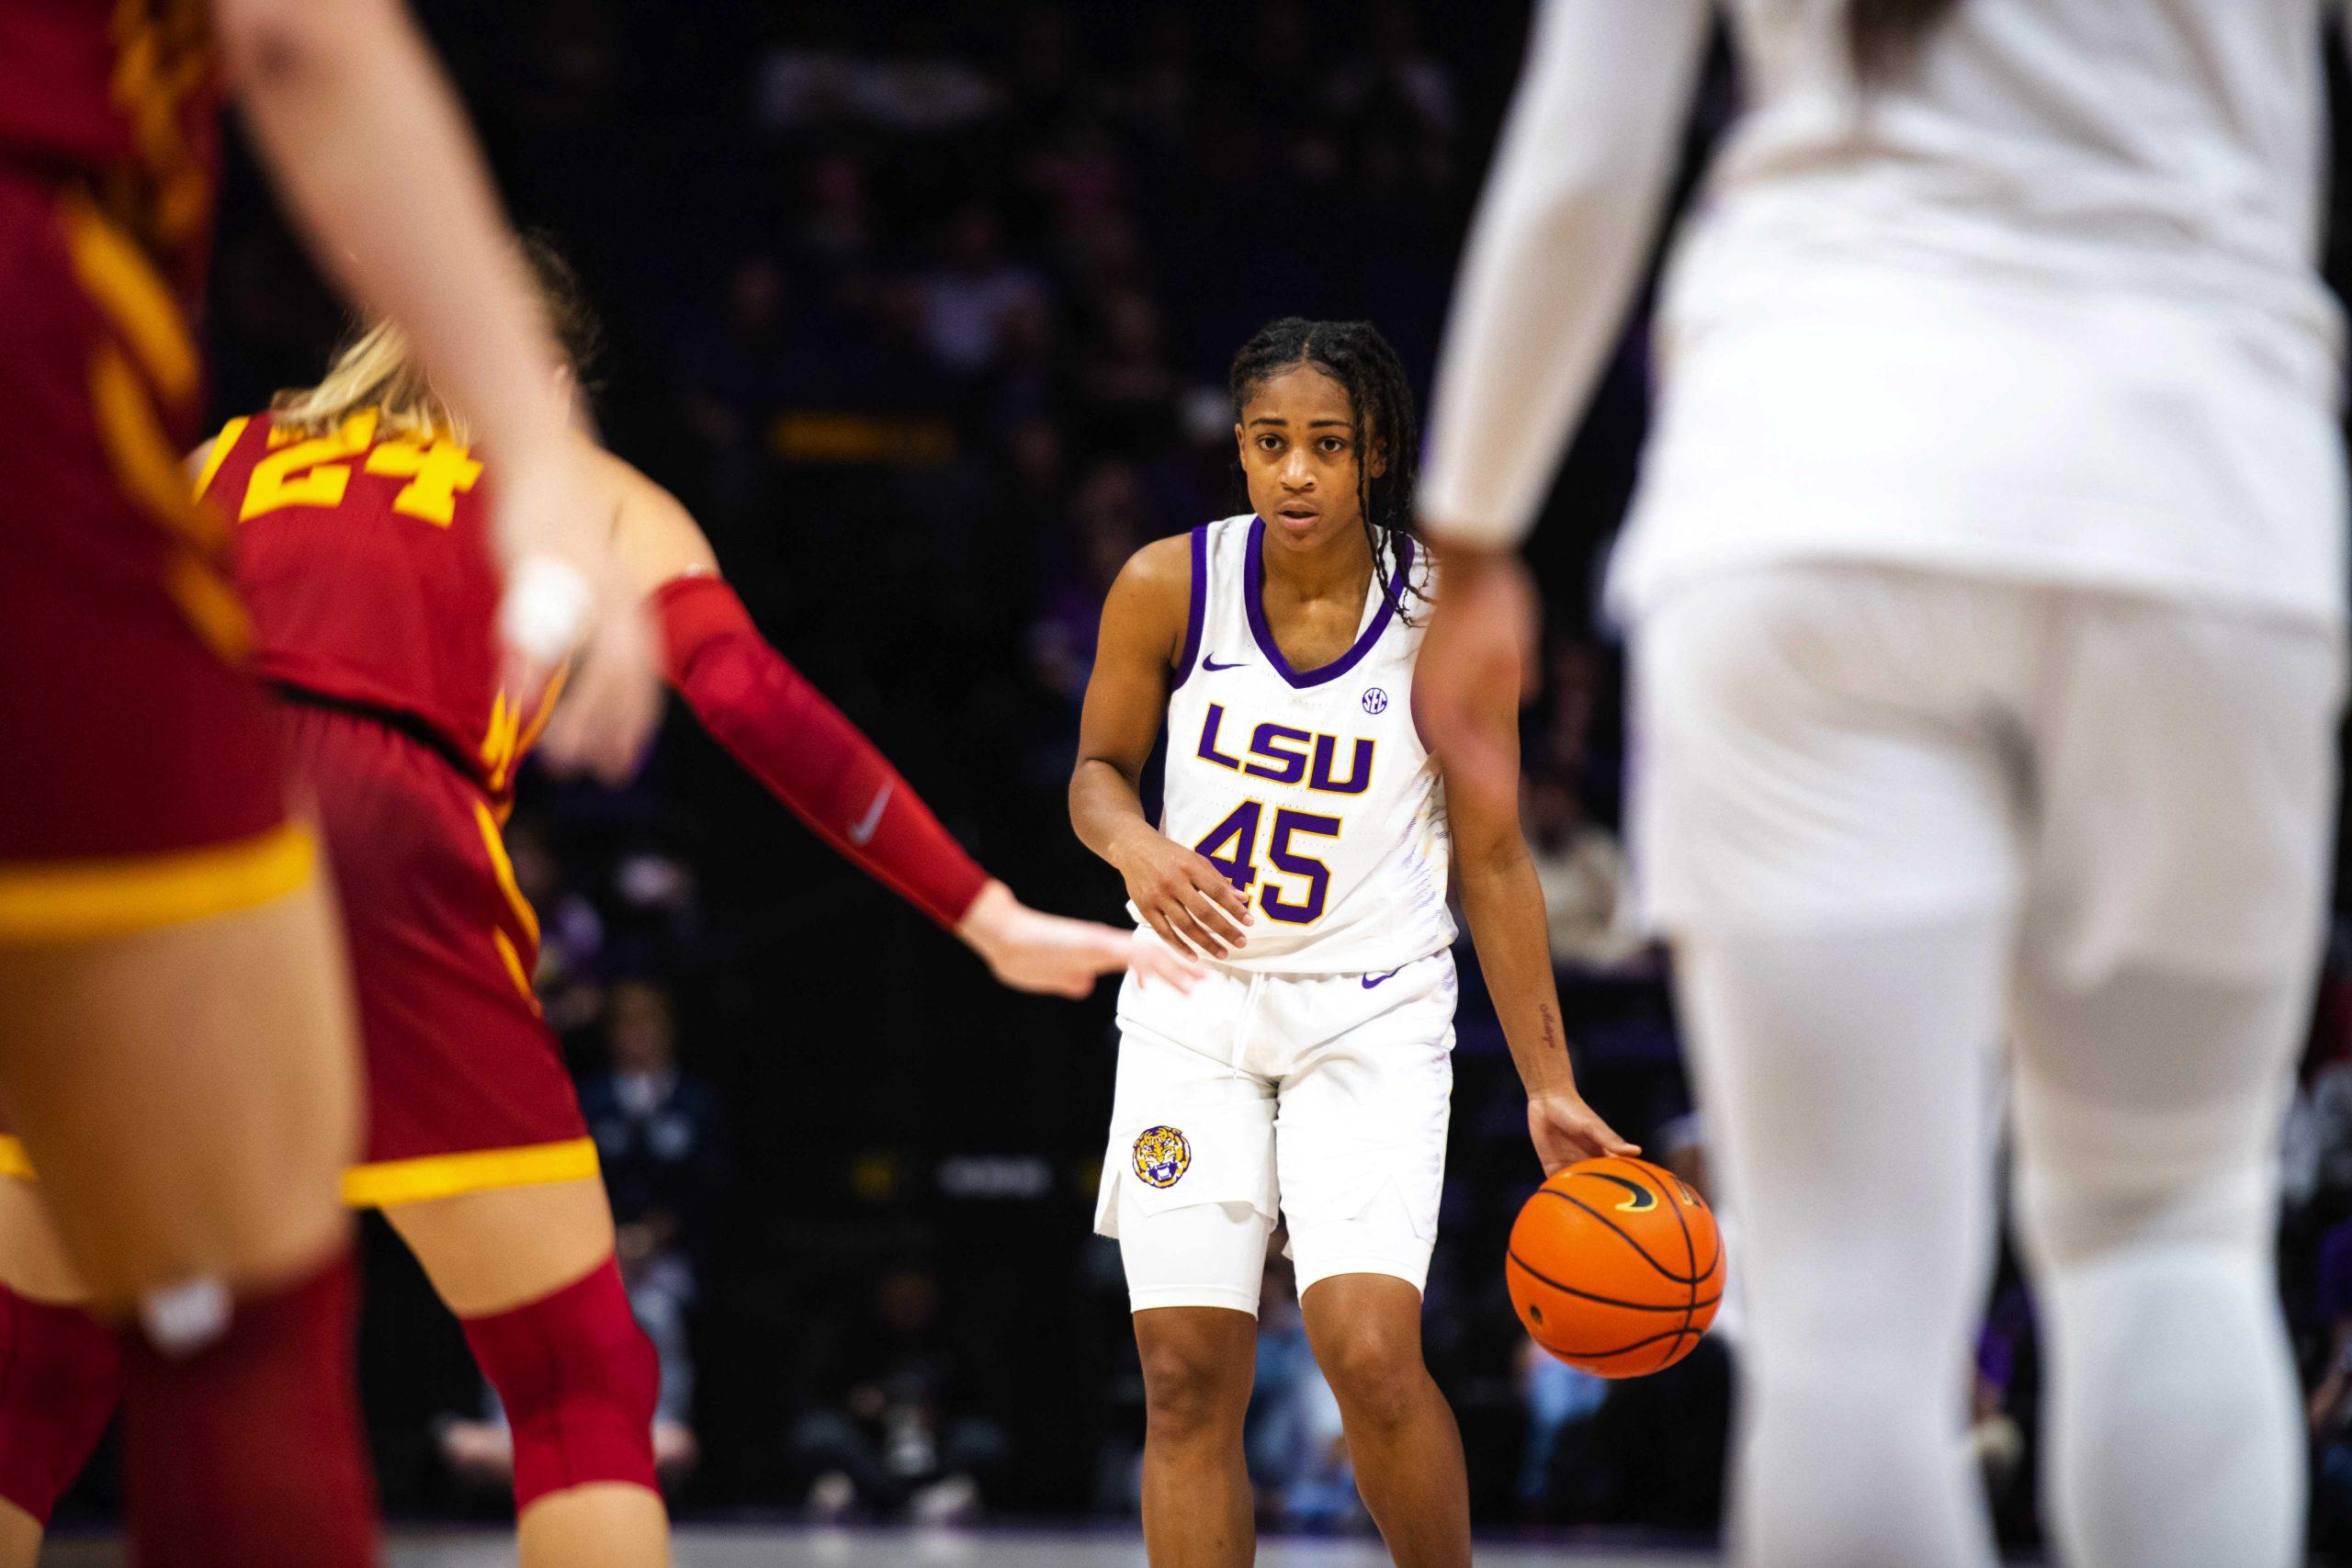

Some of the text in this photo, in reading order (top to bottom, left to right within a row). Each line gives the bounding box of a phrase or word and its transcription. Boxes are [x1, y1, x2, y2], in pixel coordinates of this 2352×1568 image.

[239, 405, 483, 528] 24
[1196, 701, 1376, 795] LSU
[1363, 687, 1387, 714] SEC
[1194, 797, 1342, 925] 45
